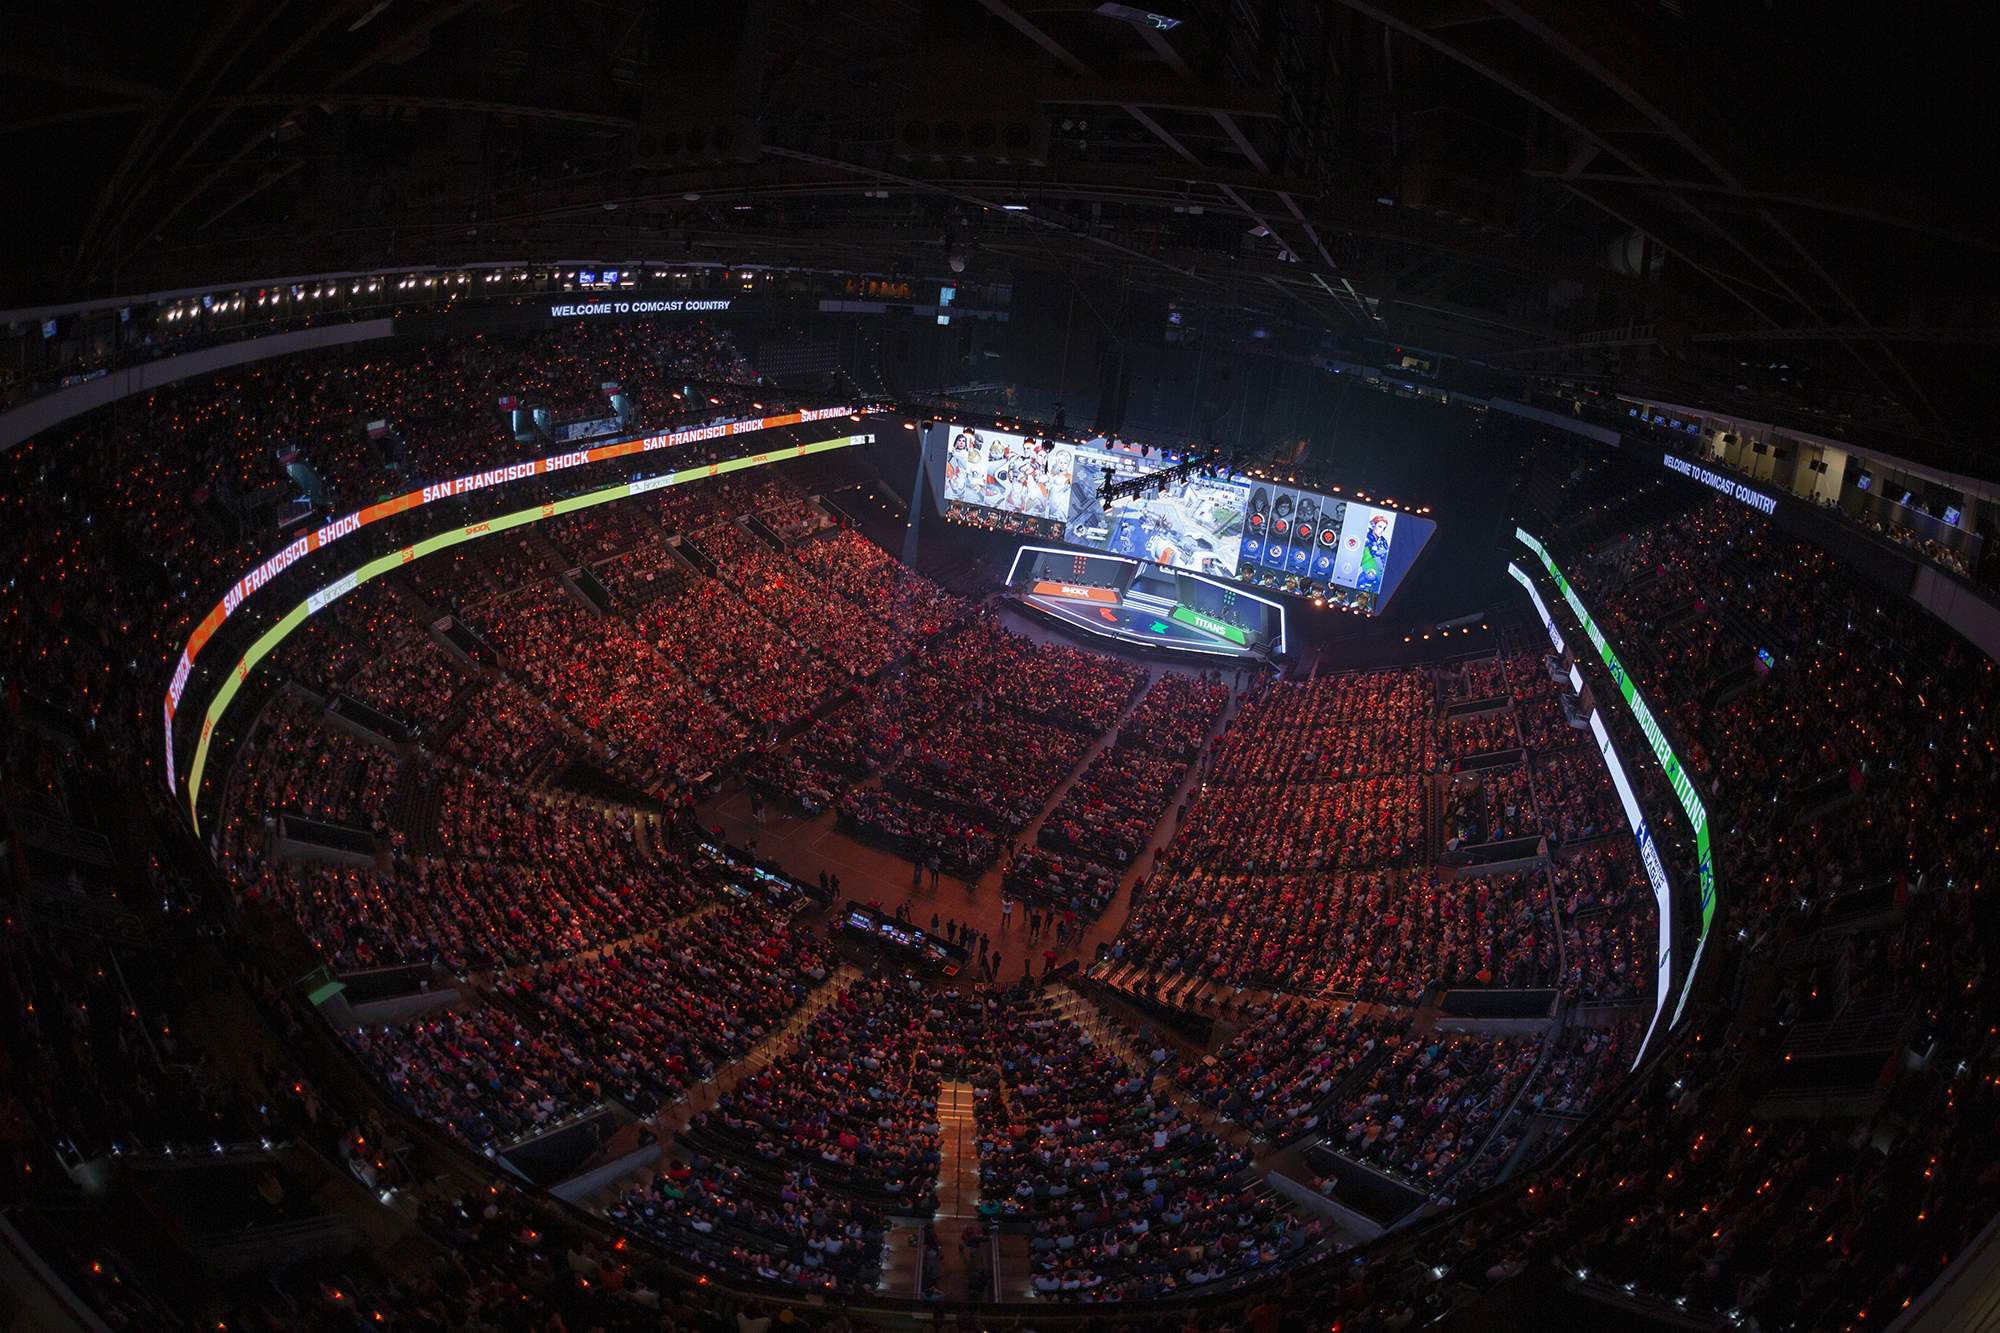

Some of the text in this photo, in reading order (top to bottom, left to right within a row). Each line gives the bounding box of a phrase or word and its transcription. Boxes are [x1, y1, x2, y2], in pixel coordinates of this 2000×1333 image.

[551, 300, 731, 317] WELCOME TO COMCAST COUNTRY
[801, 409, 818, 422] SAN
[643, 418, 764, 451] SAN FRANCISCO SHOCK
[752, 455, 768, 463] SHOCK
[423, 450, 590, 504] SAN FRANCISCO SHOCK
[1663, 454, 1777, 516] WELCOME TO COMCAST COUNTRY
[465, 523, 491, 536] SHOCK
[223, 512, 361, 617] SAN FRANCISCO SHOCK
[325, 579, 358, 603] LEAGUE
[1061, 586, 1090, 598] SHOCK
[1194, 616, 1226, 636] TITANS
[169, 649, 191, 704] SHOCK
[1630, 688, 1707, 835] VANCOUVER TITANS
[1643, 847, 1662, 895] LEAGUE
[1646, 838, 1665, 885] OVERWATCH
